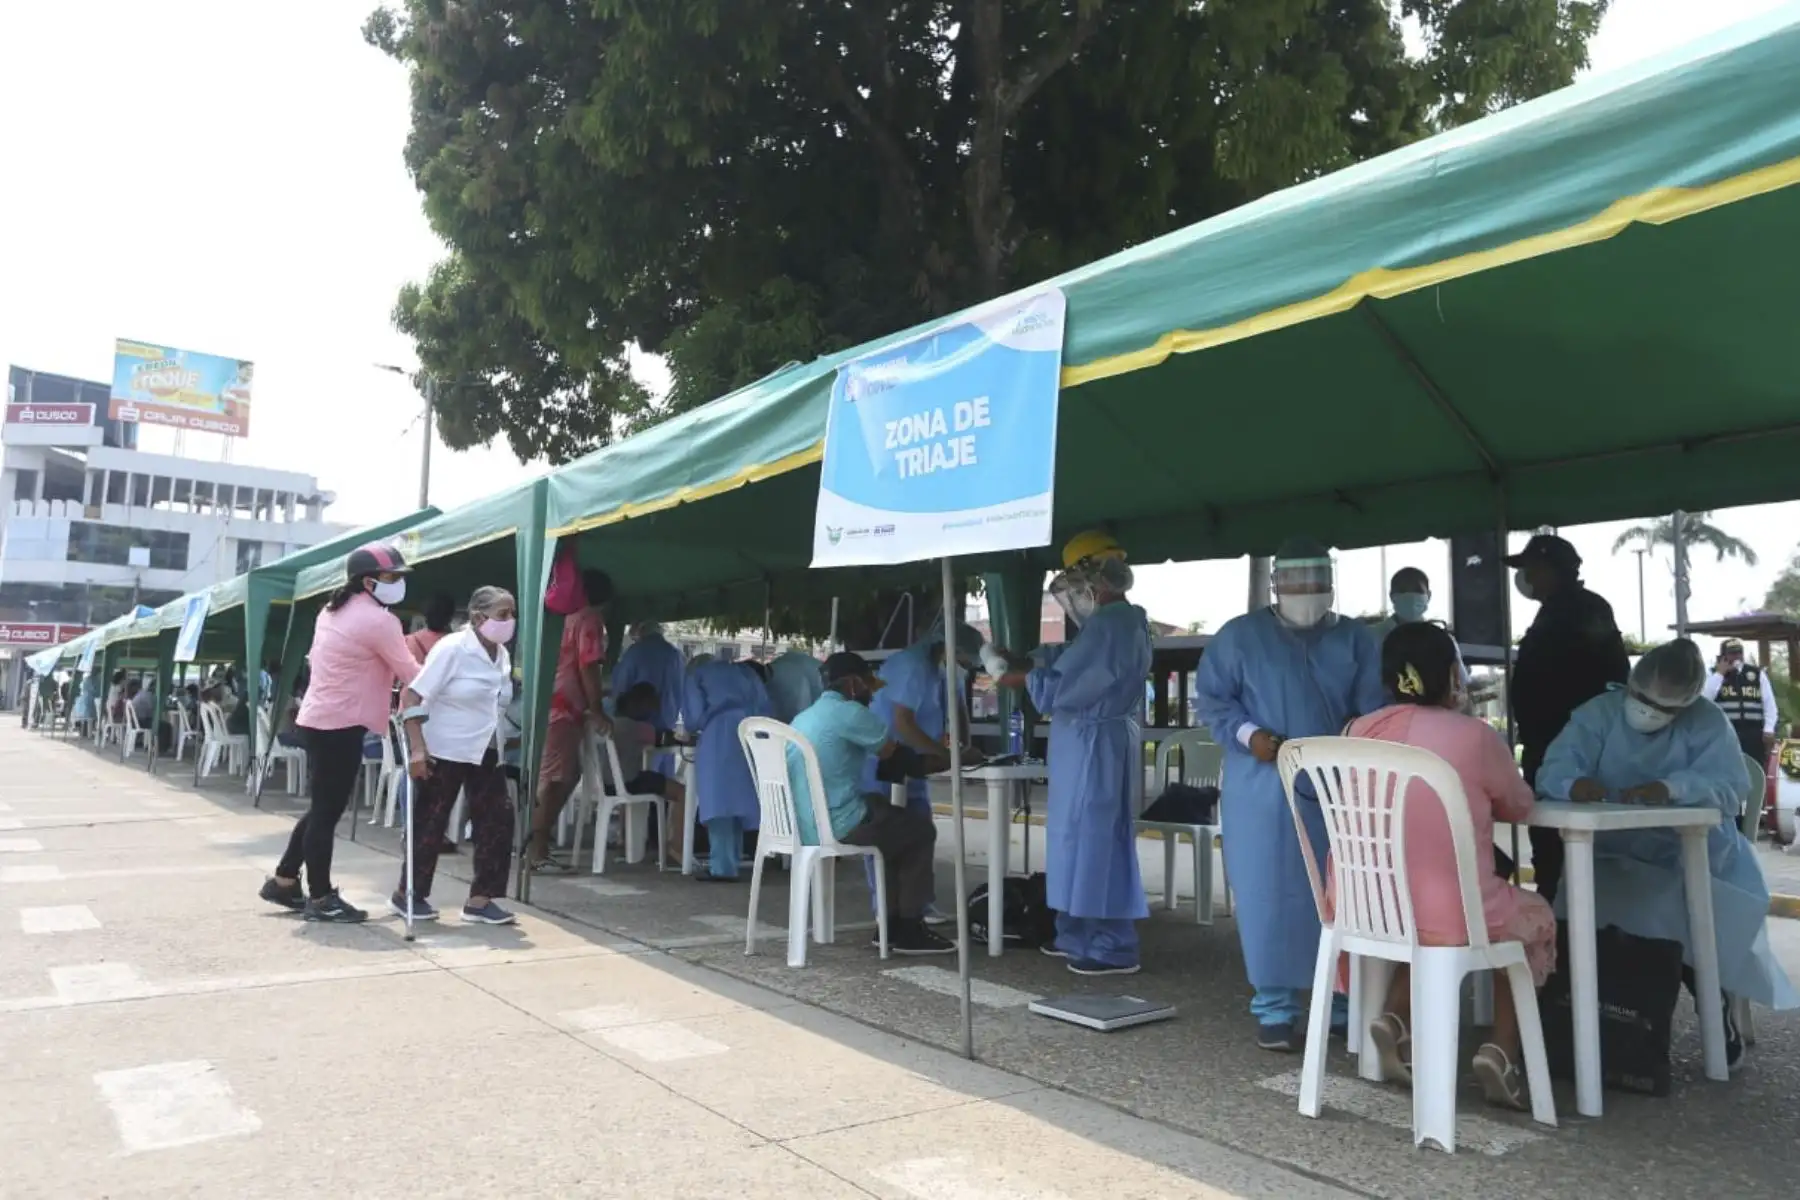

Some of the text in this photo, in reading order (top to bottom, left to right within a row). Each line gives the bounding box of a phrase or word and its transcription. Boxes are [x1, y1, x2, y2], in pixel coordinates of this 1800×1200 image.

[36, 410, 77, 420] CUSCO
[189, 416, 240, 433] CUSCO
[885, 396, 990, 449] ZONA DE
[895, 434, 977, 479] TRIAJE
[12, 630, 50, 639] CUSCO
[1722, 685, 1761, 697] OLICIA
